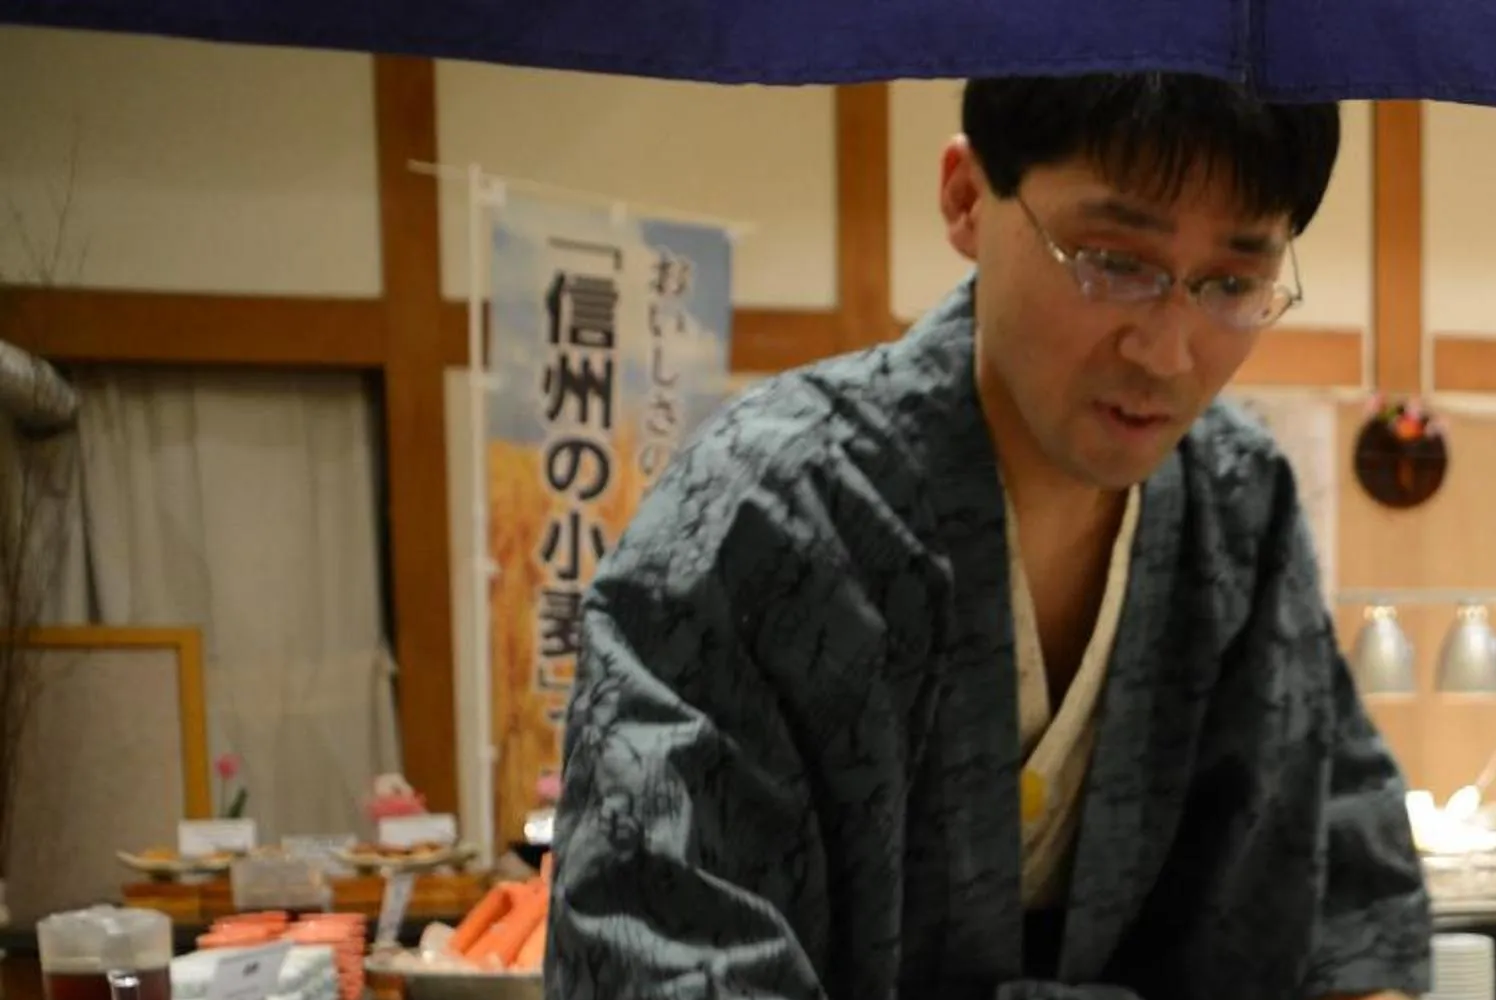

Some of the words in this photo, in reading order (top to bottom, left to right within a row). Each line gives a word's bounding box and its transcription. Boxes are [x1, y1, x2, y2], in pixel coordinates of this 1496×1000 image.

[537, 236, 623, 722] 「信州の小麦」
